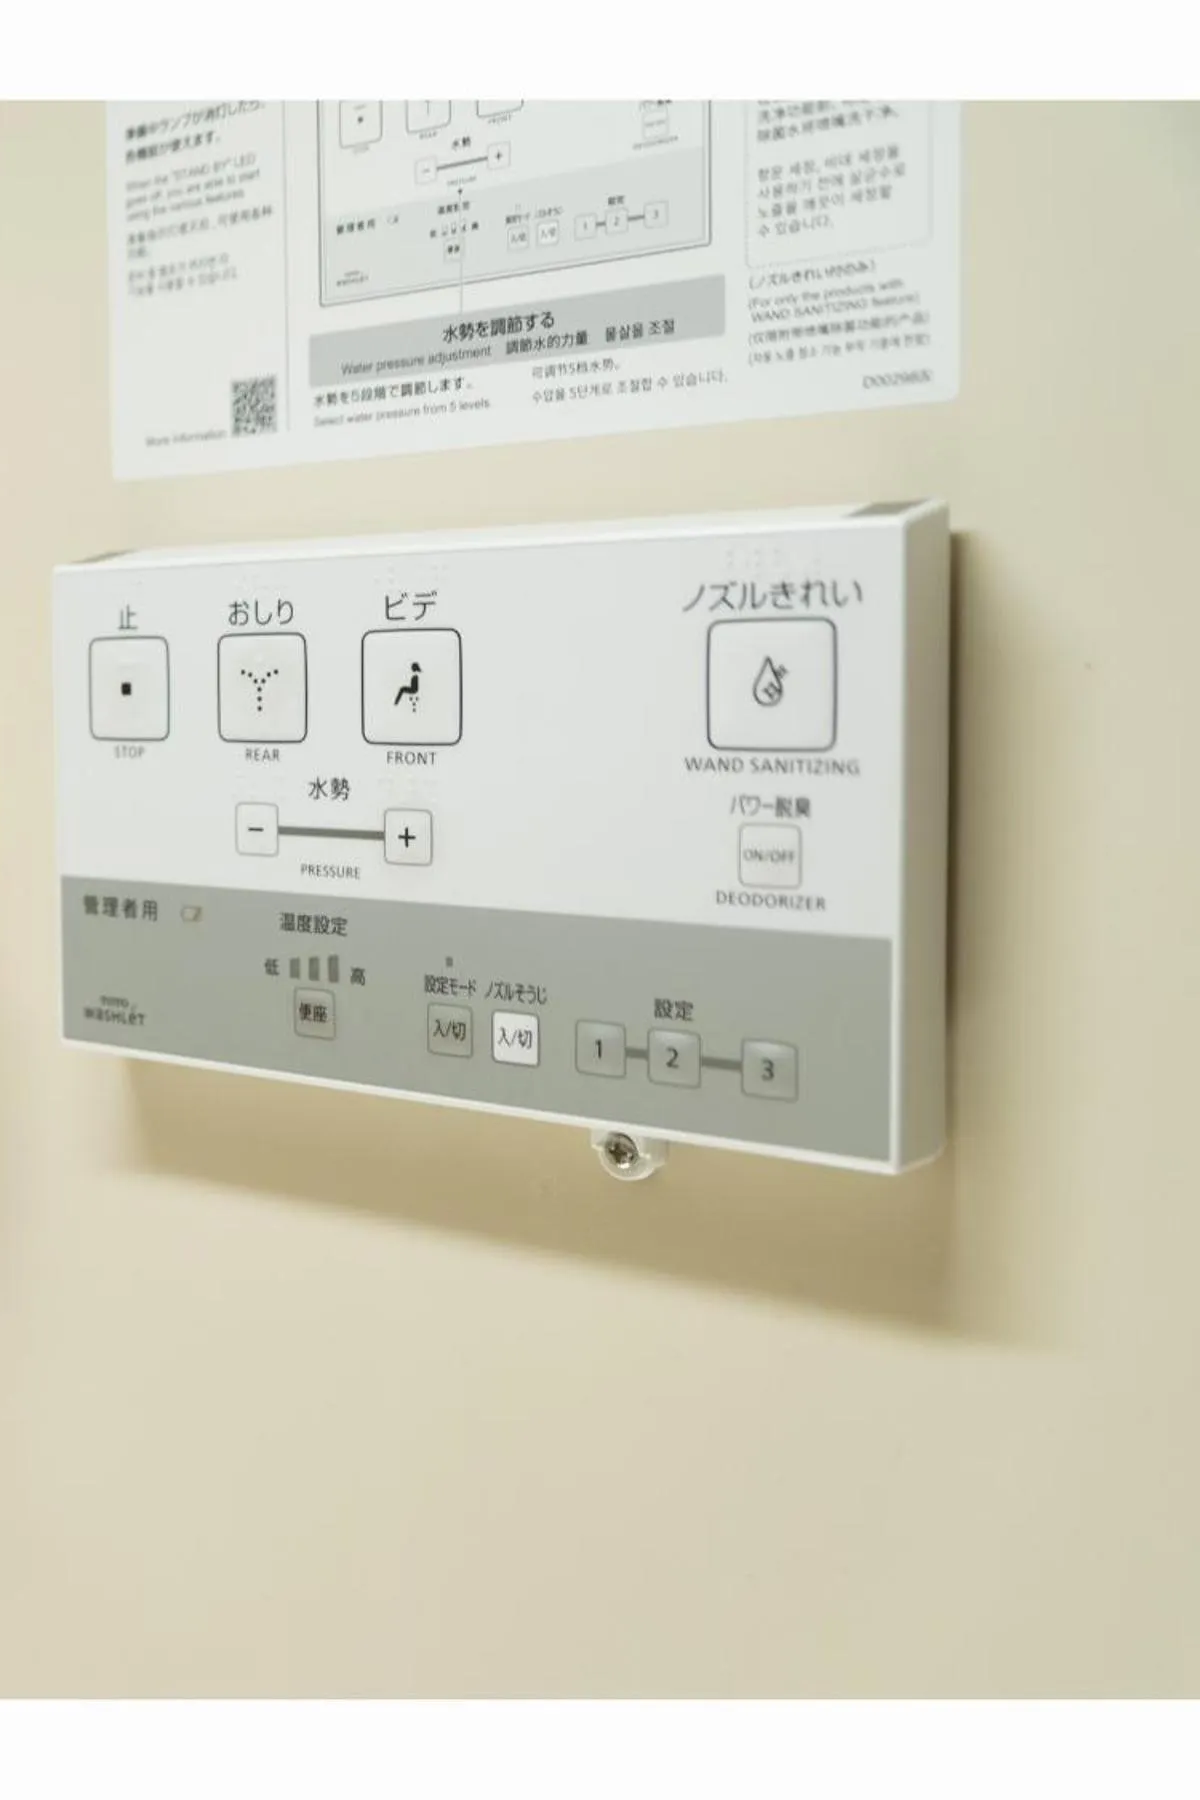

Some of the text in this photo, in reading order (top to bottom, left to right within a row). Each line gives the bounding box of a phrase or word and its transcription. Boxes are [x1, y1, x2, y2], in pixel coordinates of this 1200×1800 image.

[443, 312, 555, 343] 水勢を調節する
[341, 345, 492, 376] Water pressure adjustment
[384, 590, 439, 622] ビデ
[682, 579, 864, 612] ノズルきれい
[118, 605, 139, 631] 止
[228, 599, 295, 626] おしり
[114, 745, 145, 760] STOP
[245, 747, 281, 763] REAR
[386, 750, 438, 766] FRONT
[684, 756, 861, 776] WAND SANITIZING
[308, 776, 351, 802] 水勢
[730, 793, 812, 819] パワー脱臭
[743, 848, 796, 865] ON/OFF
[300, 862, 362, 880] PRESSURE
[83, 894, 159, 923] 管理者用
[715, 888, 827, 912] DEODORIZER
[279, 911, 349, 937] 温度設定
[264, 957, 280, 977] 低
[350, 966, 367, 986] 高
[423, 973, 478, 997] 設定モード
[484, 979, 549, 1006] ノズルそうじ
[299, 1002, 329, 1025] 便座
[653, 997, 695, 1022] 設定
[432, 1018, 468, 1043] 入/切
[498, 1026, 534, 1050] 入/切
[594, 1038, 776, 1082] 1 2 3
